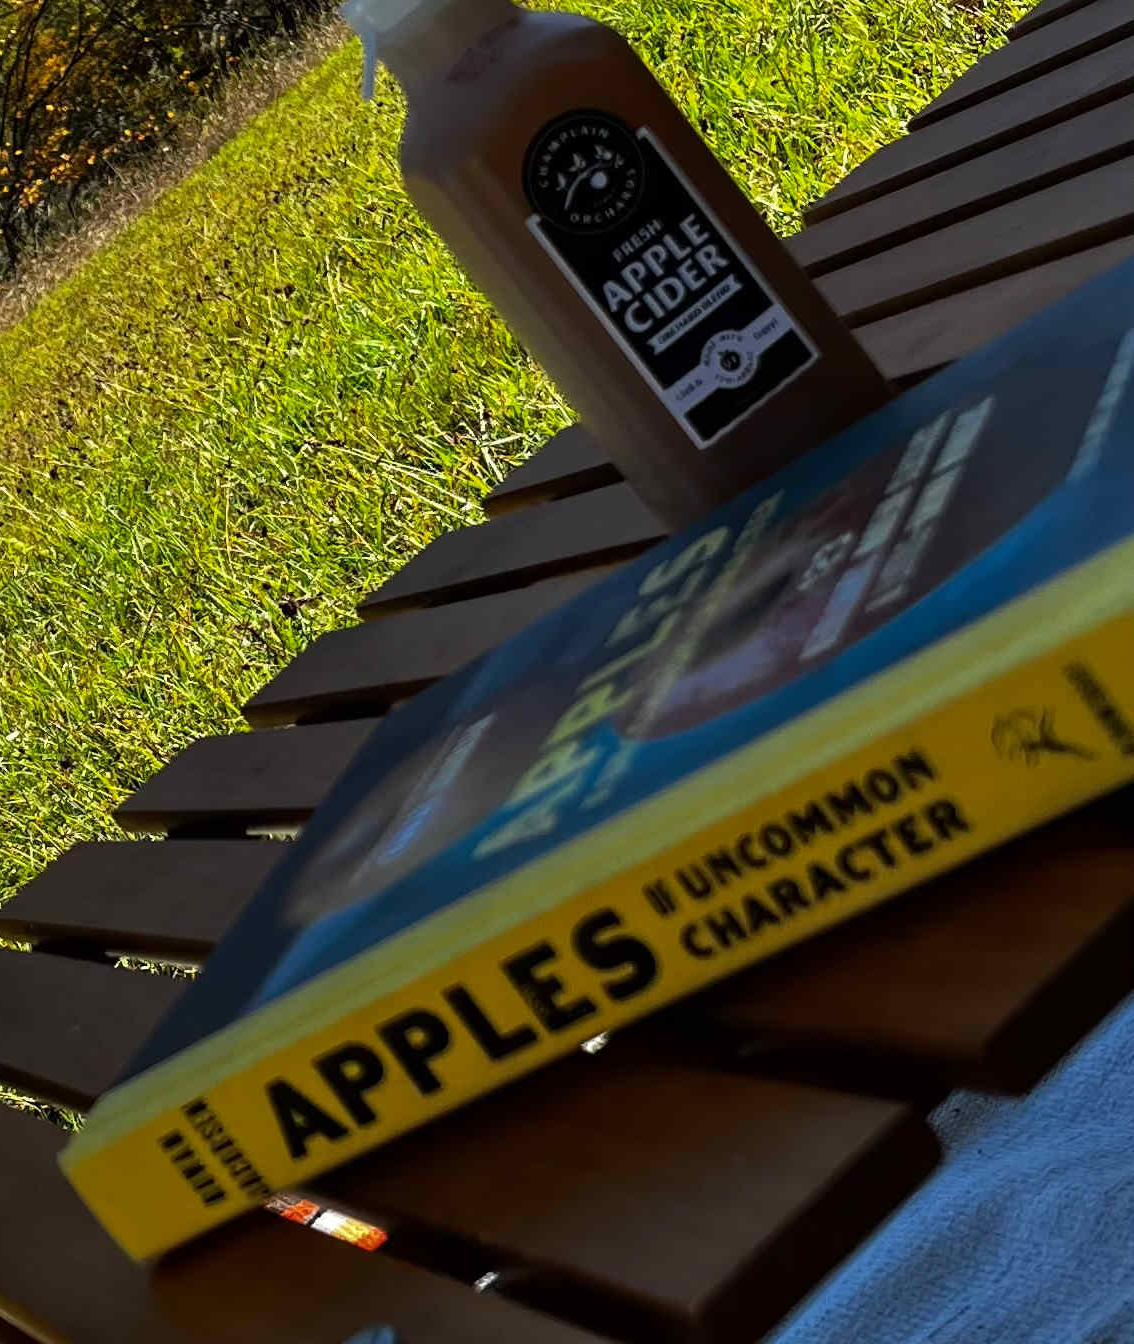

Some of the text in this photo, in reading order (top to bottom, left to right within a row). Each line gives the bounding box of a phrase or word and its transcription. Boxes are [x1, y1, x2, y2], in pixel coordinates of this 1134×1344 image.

[602, 213, 710, 312] APPLE
[612, 218, 665, 263] FRESH
[623, 244, 730, 334] CIDER
[674, 748, 939, 902] UNCOMMON
[678, 797, 970, 960] CHARACTER
[265, 907, 659, 1160] APPLES
